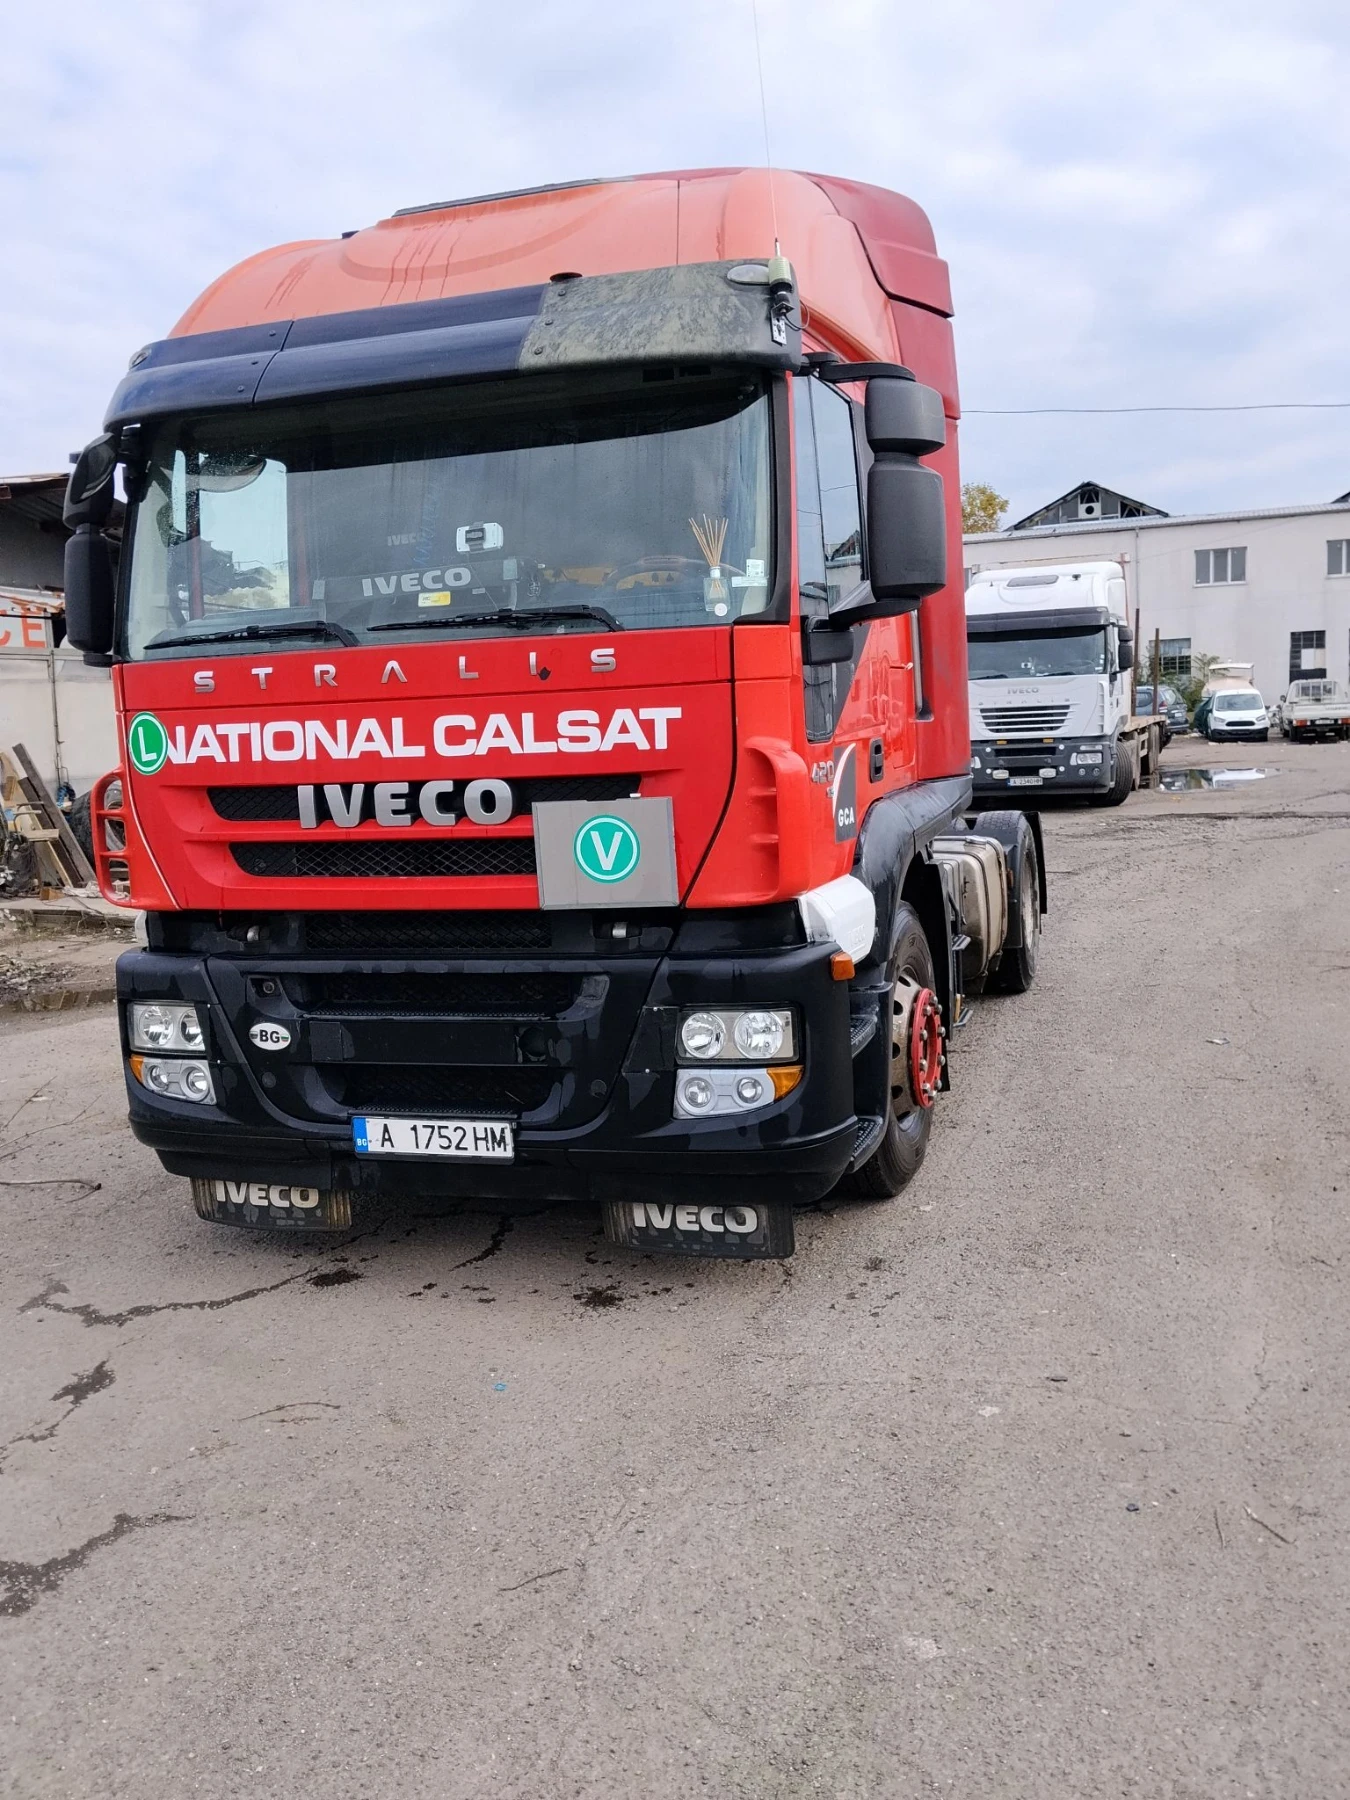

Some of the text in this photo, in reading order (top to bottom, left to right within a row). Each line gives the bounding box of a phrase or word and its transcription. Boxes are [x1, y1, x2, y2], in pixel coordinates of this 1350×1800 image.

[362, 567, 471, 597] IVECO
[193, 648, 616, 693] STRALIS
[433, 707, 682, 757] CALSAT
[812, 761, 835, 784] 420
[297, 779, 512, 829] IVECO
[838, 806, 855, 827] GCA
[260, 1029, 280, 1043] BG
[356, 1138, 367, 1146] BG
[380, 1123, 394, 1148] A
[410, 1124, 468, 1151] 1752
[215, 1180, 319, 1208] IVECO
[632, 1202, 757, 1233] IVECO
